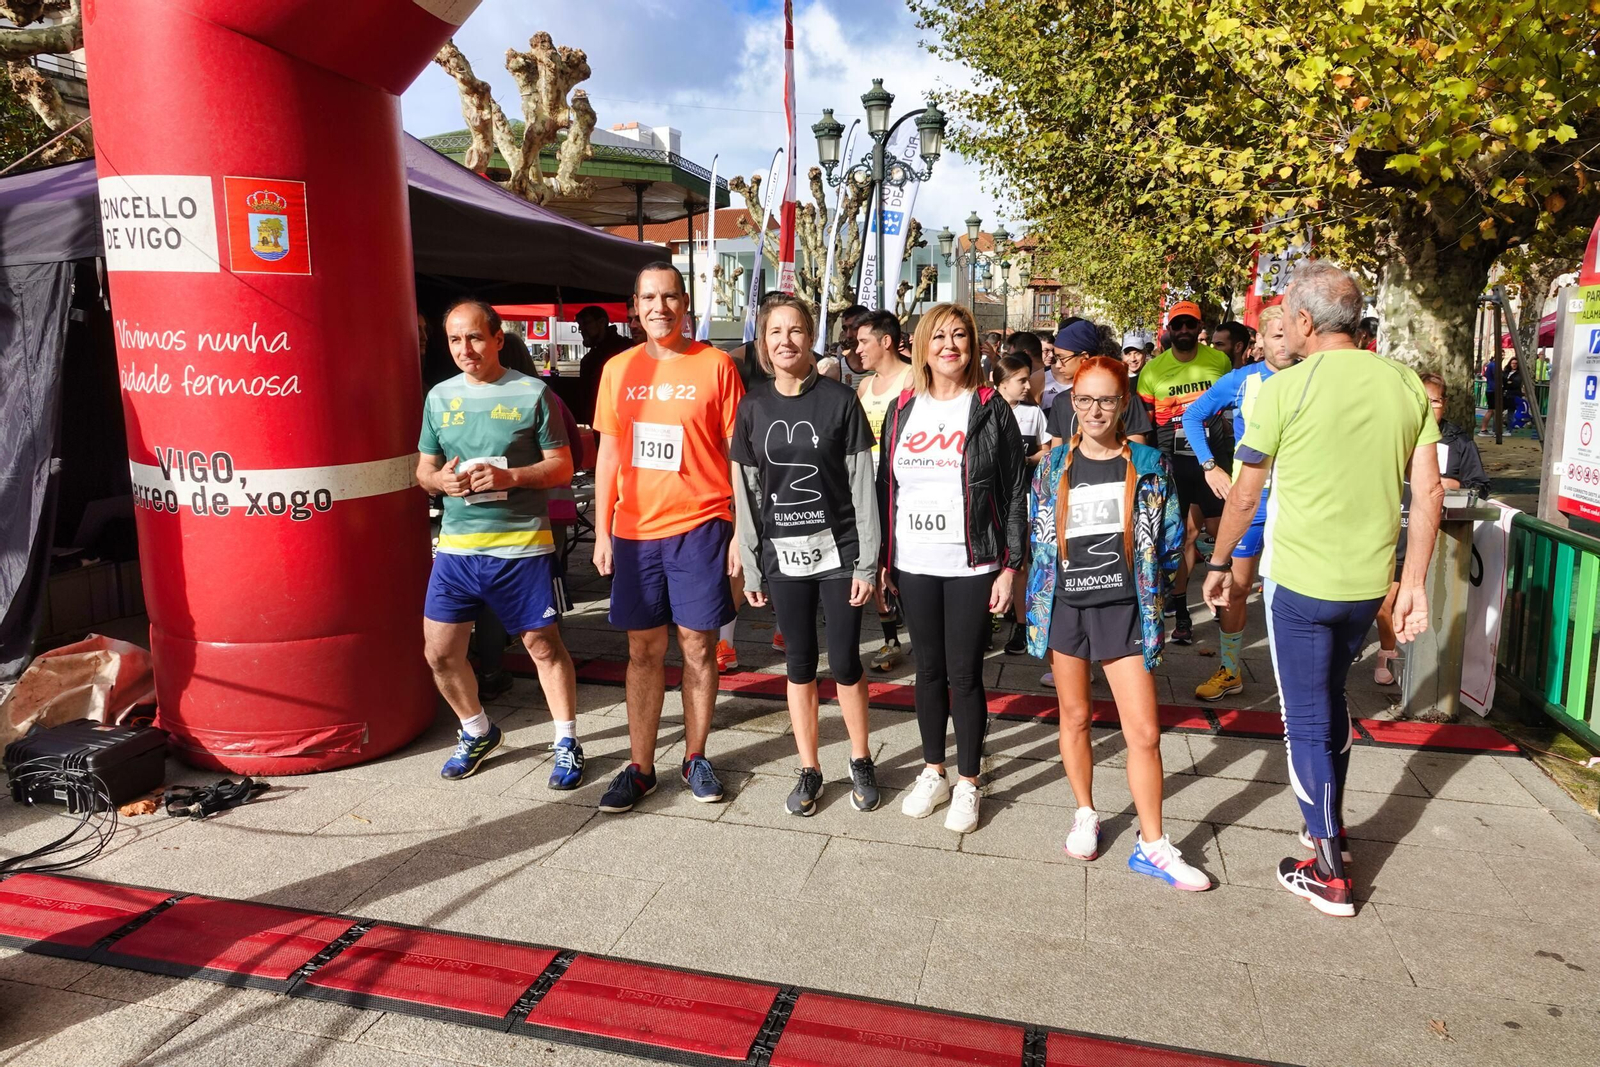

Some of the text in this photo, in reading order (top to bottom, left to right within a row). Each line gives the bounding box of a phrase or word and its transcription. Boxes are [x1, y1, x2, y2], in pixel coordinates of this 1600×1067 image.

[106, 227, 182, 250] DE VIGO
[116, 318, 291, 354] Vivimos nunha
[181, 364, 302, 397] fermosa
[1168, 380, 1212, 397] 3NORTH
[640, 441, 674, 459] 1310
[155, 446, 247, 490] VIGO,
[191, 485, 230, 516] de
[245, 488, 333, 522] xogo
[1071, 501, 1109, 523] 574
[774, 510, 825, 521] EU MÓVOME
[908, 513, 946, 531] 1660
[782, 548, 823, 566] 1453
[1077, 573, 1123, 587] MÓVOME
